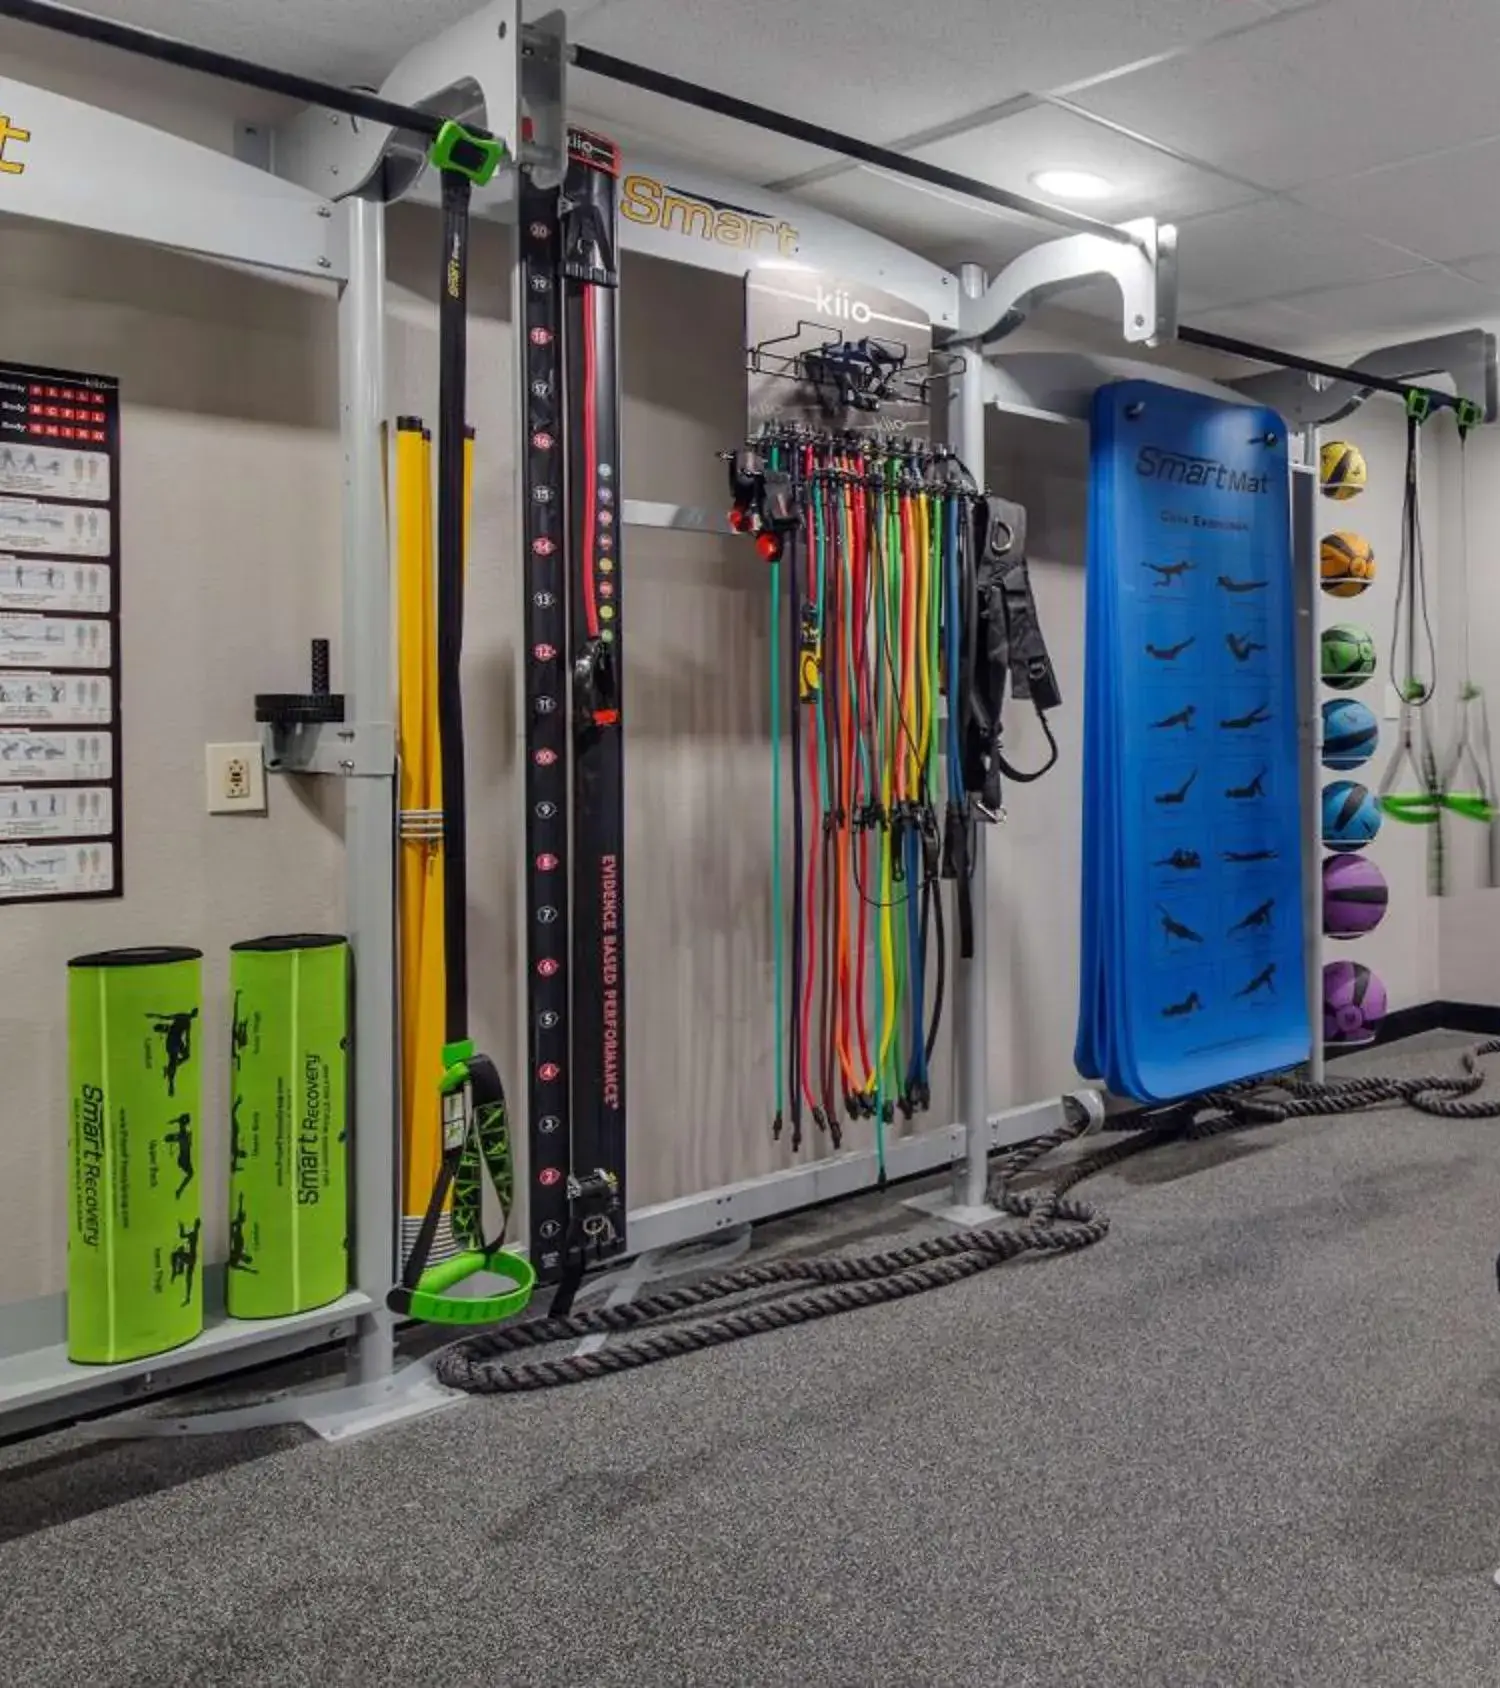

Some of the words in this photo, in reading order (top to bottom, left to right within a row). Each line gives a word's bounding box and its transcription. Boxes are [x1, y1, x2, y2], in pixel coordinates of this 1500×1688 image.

[619, 174, 799, 260] Smart
[815, 284, 872, 324] kiio
[601, 853, 618, 932] EVIDENCE
[603, 935, 618, 984] BASED
[81, 1083, 105, 1164] Smart
[297, 1133, 320, 1206] Smart
